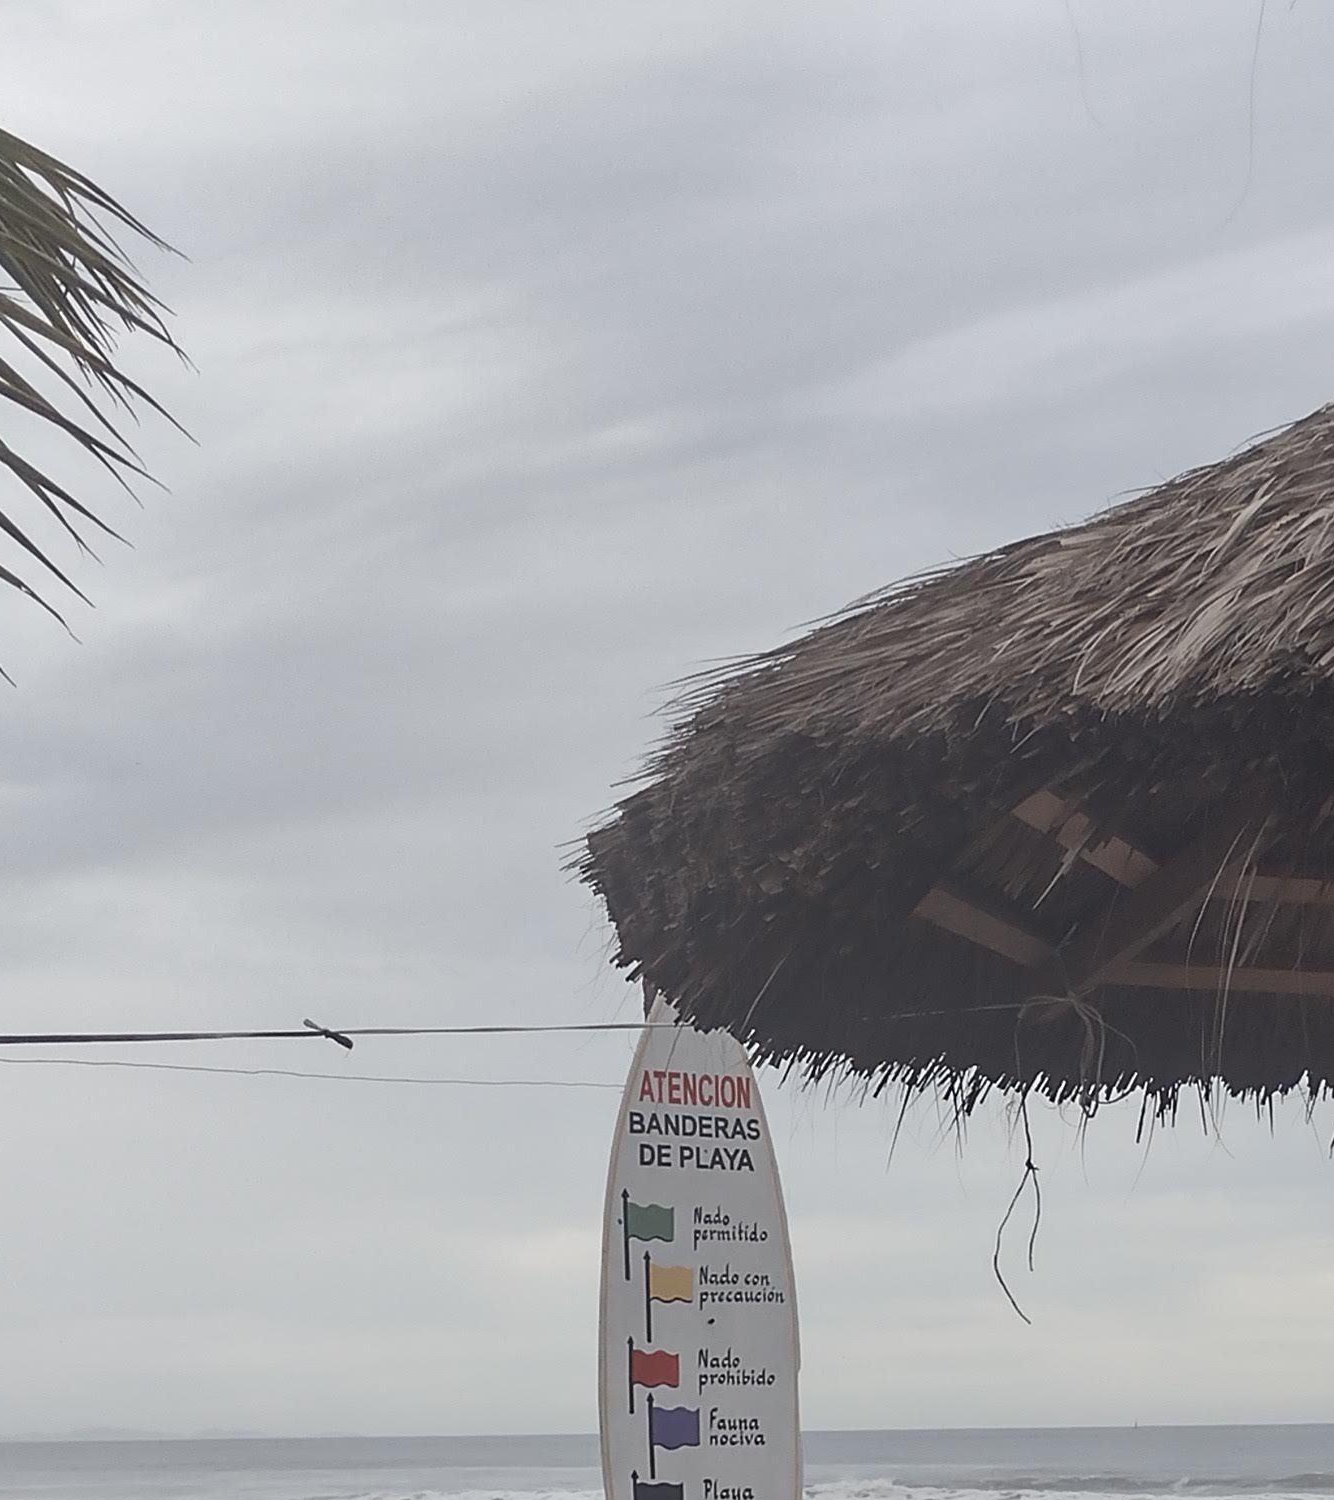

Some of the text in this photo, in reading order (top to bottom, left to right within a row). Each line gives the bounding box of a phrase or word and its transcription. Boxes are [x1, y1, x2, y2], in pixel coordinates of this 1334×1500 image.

[638, 1070, 751, 1109] ATENCION
[628, 1111, 761, 1140] BANDERAS
[639, 1143, 755, 1172] DE PLAYA
[693, 1206, 730, 1226] Nado
[693, 1222, 768, 1251] permitido
[699, 1263, 770, 1286] Nado con
[699, 1286, 785, 1311] precaución
[697, 1347, 740, 1369] Nado
[698, 1368, 776, 1396] prohibido
[709, 1407, 760, 1431] Fauna
[709, 1432, 766, 1446] nociva
